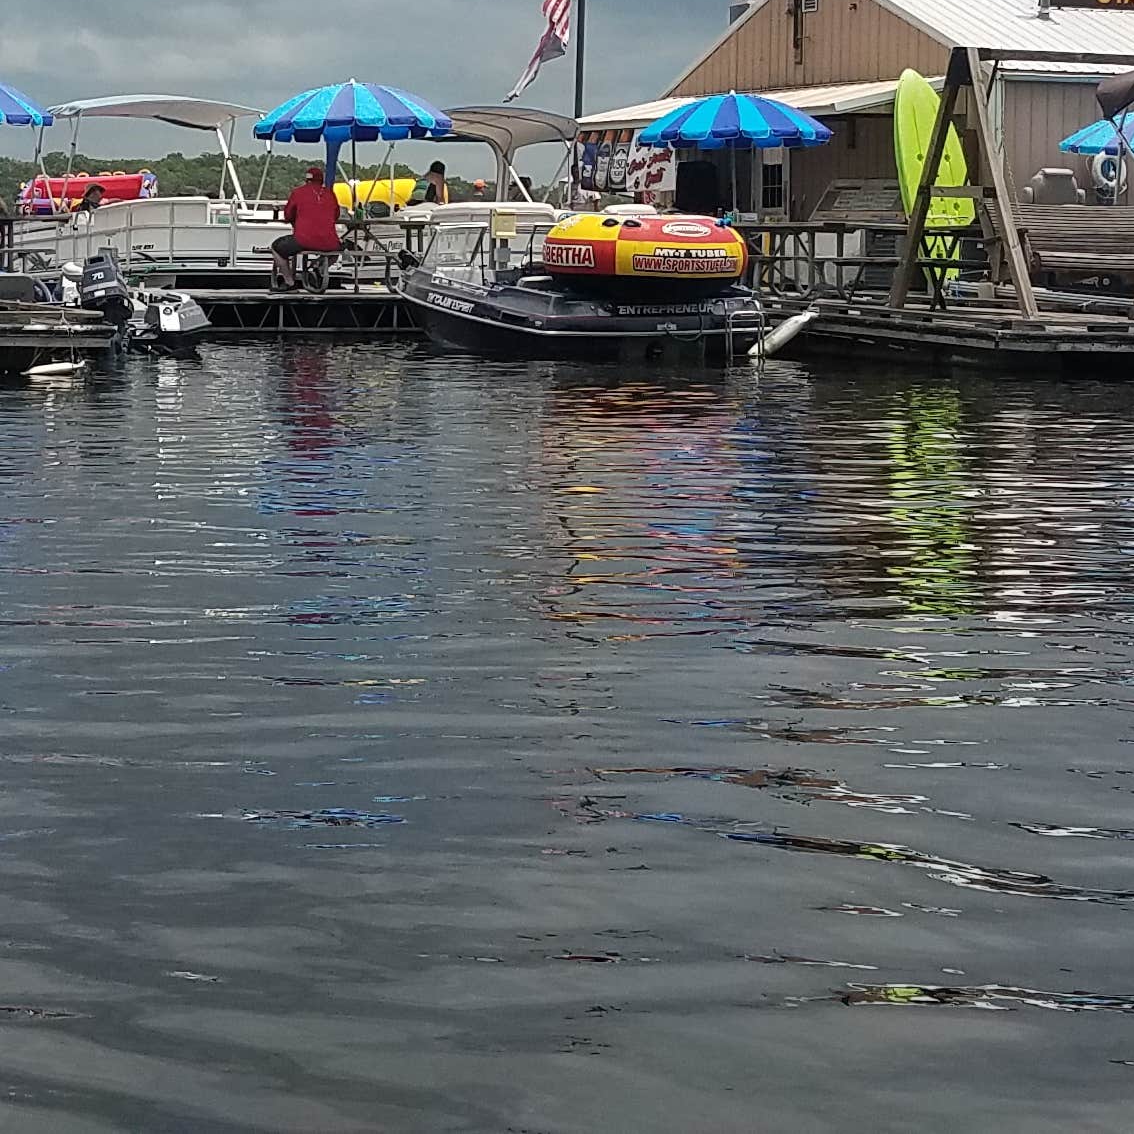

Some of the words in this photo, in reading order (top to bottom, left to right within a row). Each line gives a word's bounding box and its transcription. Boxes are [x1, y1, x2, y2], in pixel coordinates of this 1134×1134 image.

[546, 245, 593, 265] BERTHA
[91, 271, 104, 281] 70
[619, 303, 715, 315] ENTREPRENEUR
